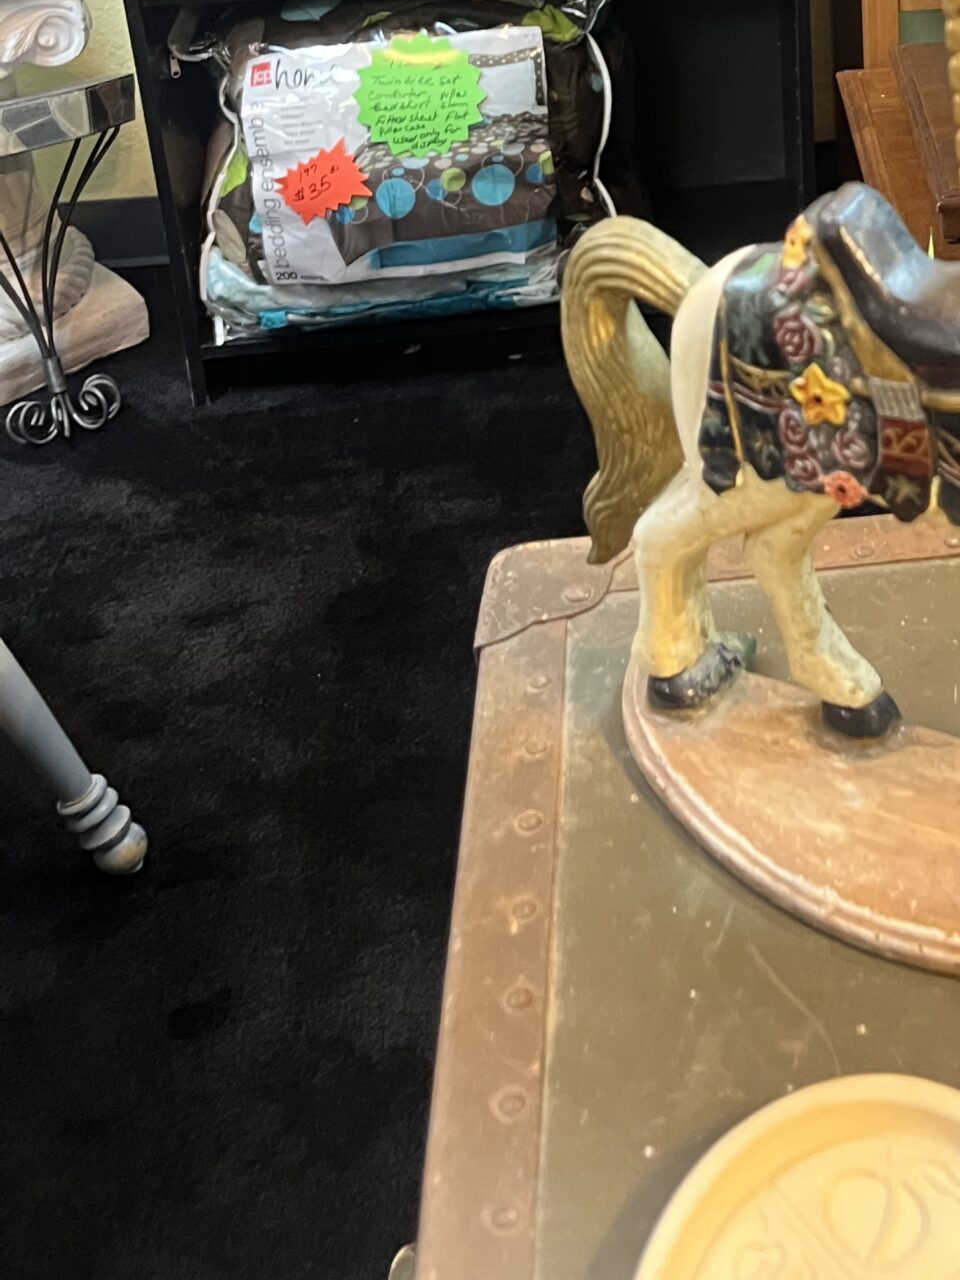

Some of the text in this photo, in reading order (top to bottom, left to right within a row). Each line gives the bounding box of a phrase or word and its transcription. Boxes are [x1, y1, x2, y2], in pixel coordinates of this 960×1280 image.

[249, 101, 290, 269] bedding ensembe
[275, 271, 298, 281] 200
